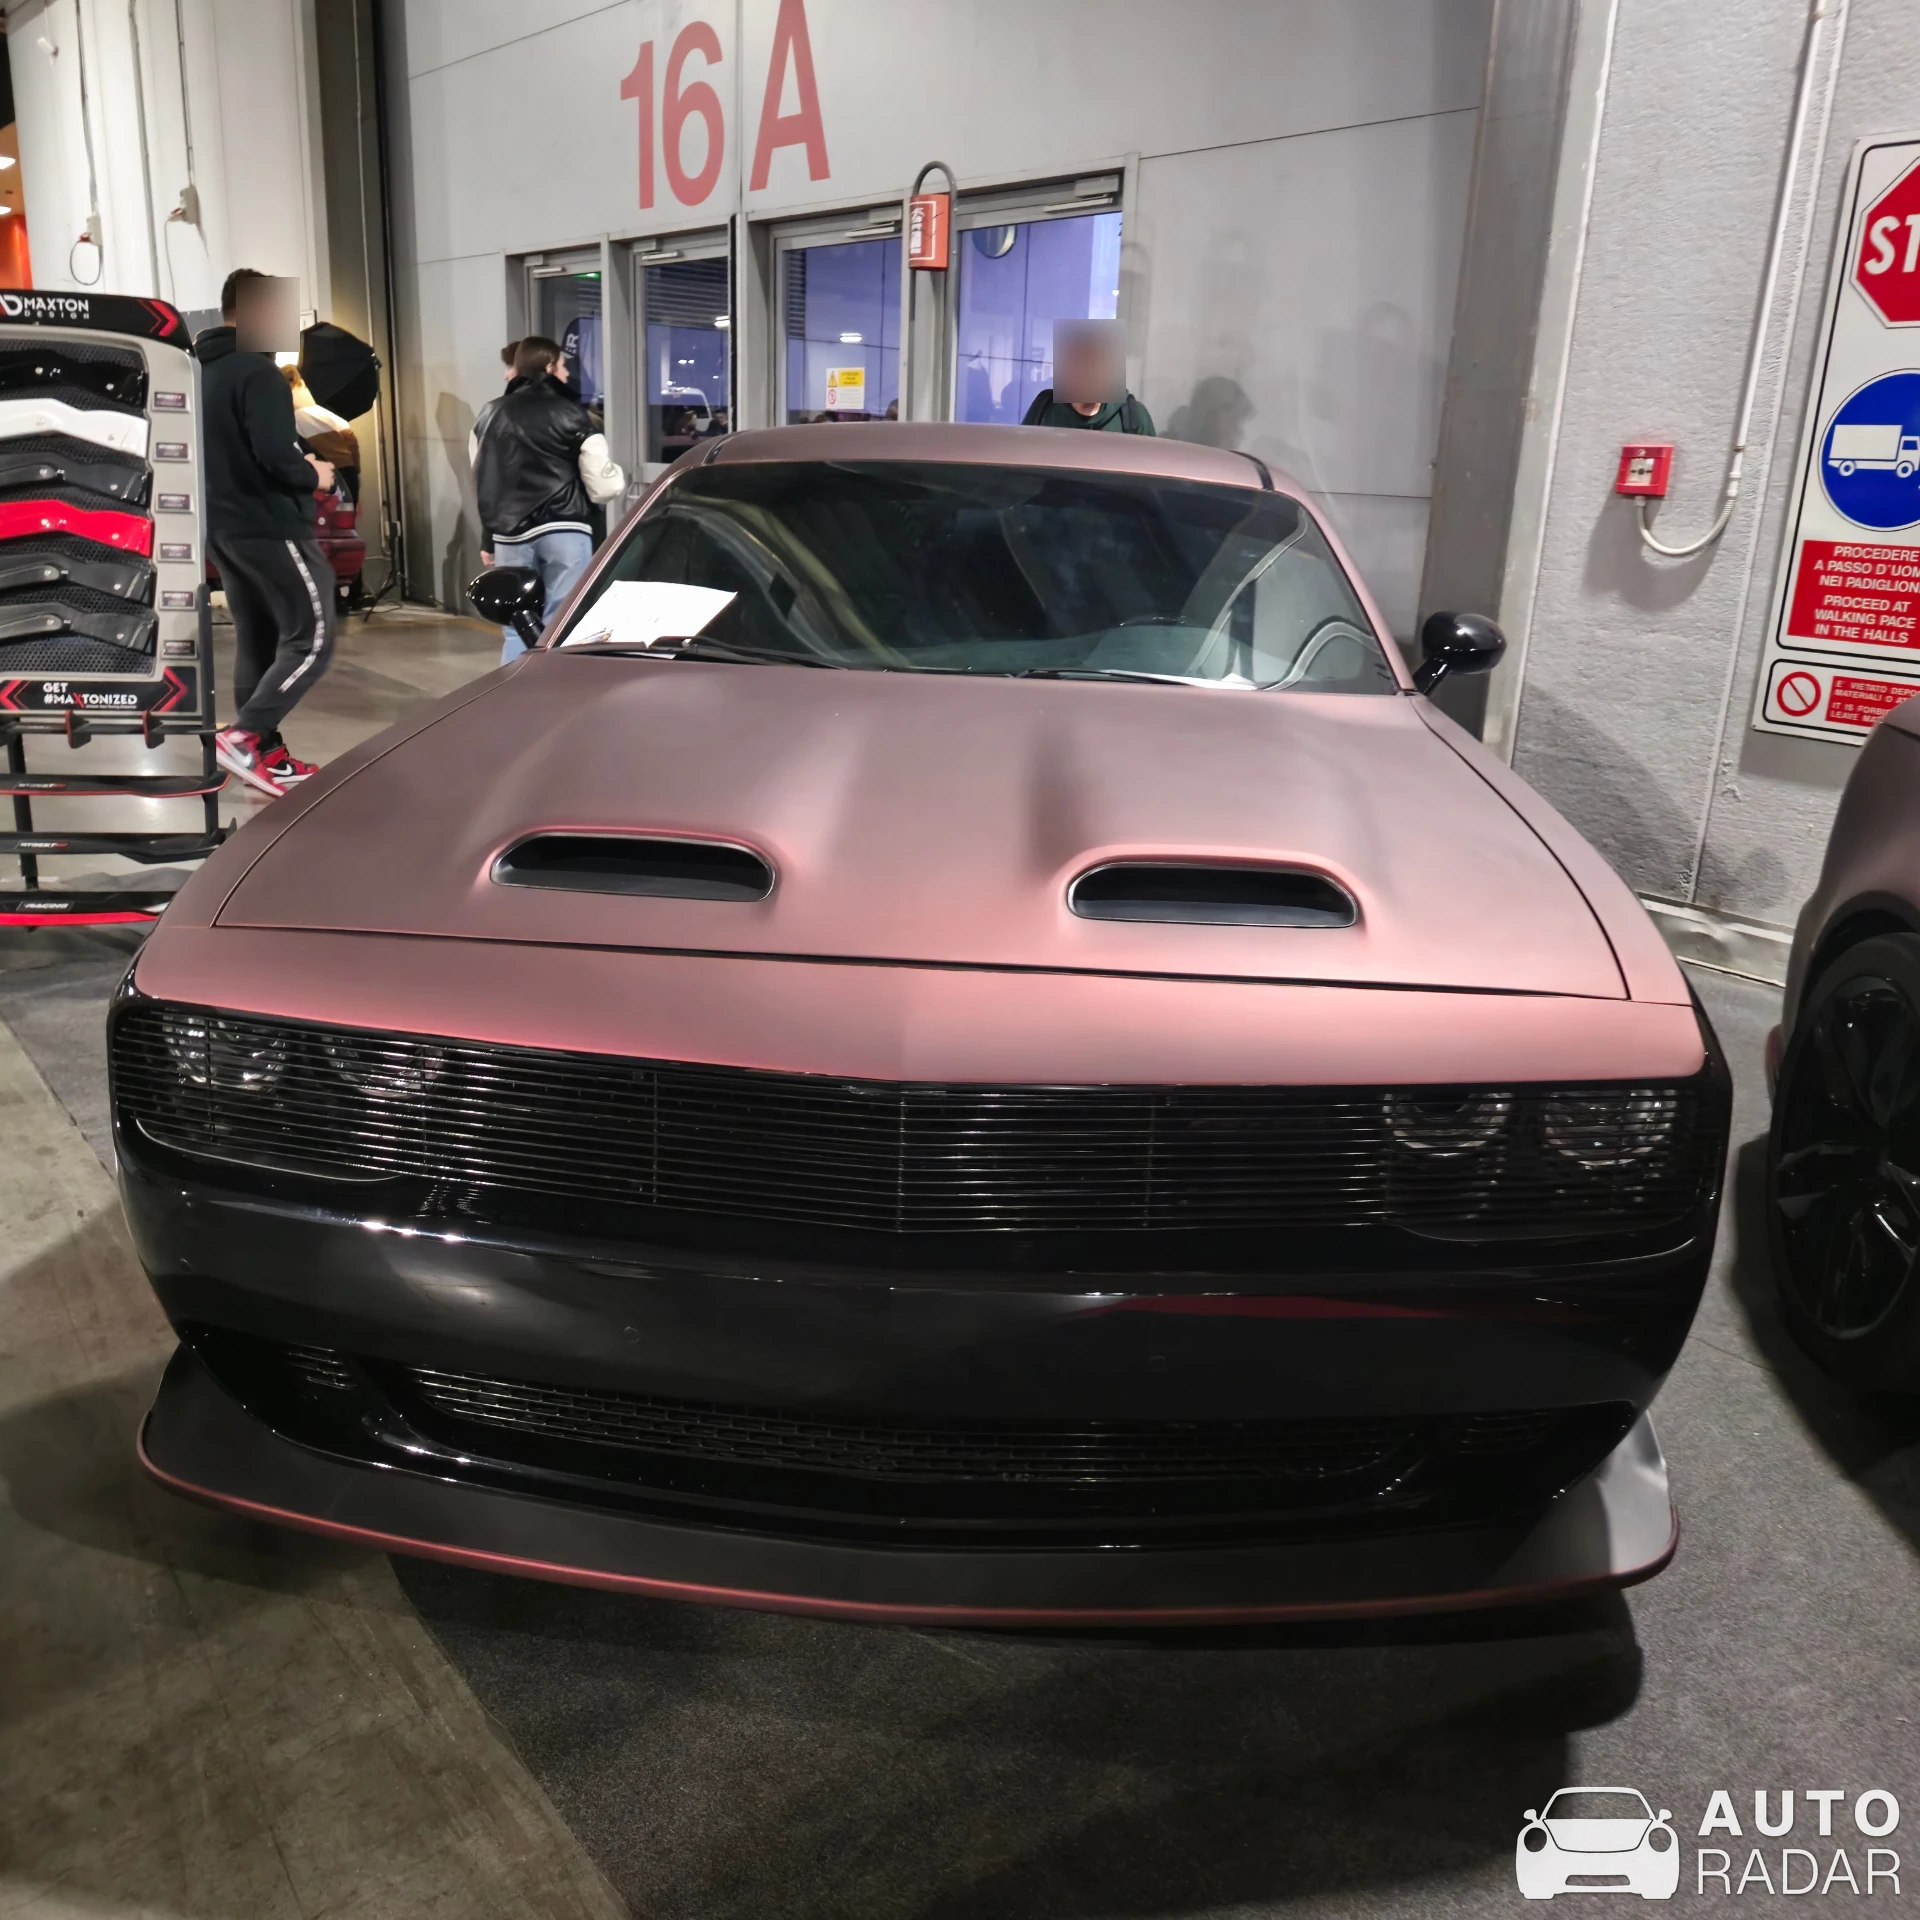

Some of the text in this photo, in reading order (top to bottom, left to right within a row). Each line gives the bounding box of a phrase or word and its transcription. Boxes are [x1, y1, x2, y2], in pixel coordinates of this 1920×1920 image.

[620, 0, 831, 210] 16 A
[24, 298, 90, 312] MAXTON
[24, 310, 90, 319] DESIGN
[1833, 545, 1920, 562] PROCEDERE
[1813, 559, 1824, 571] A
[1827, 560, 1873, 574] PASSO
[1818, 575, 1843, 587] NEI
[1823, 595, 1912, 613] PROCEED AT
[1814, 609, 1917, 629] WALKING PACE
[1814, 624, 1910, 643] IN THE HALLS
[42, 682, 69, 693] GET
[1834, 689, 1883, 701] MATERIALI
[1851, 682, 1888, 693] VIETATO
[1890, 687, 1918, 697] DEPO
[43, 693, 138, 708] #MAXTONIZED
[1831, 710, 1860, 721] LEAVE
